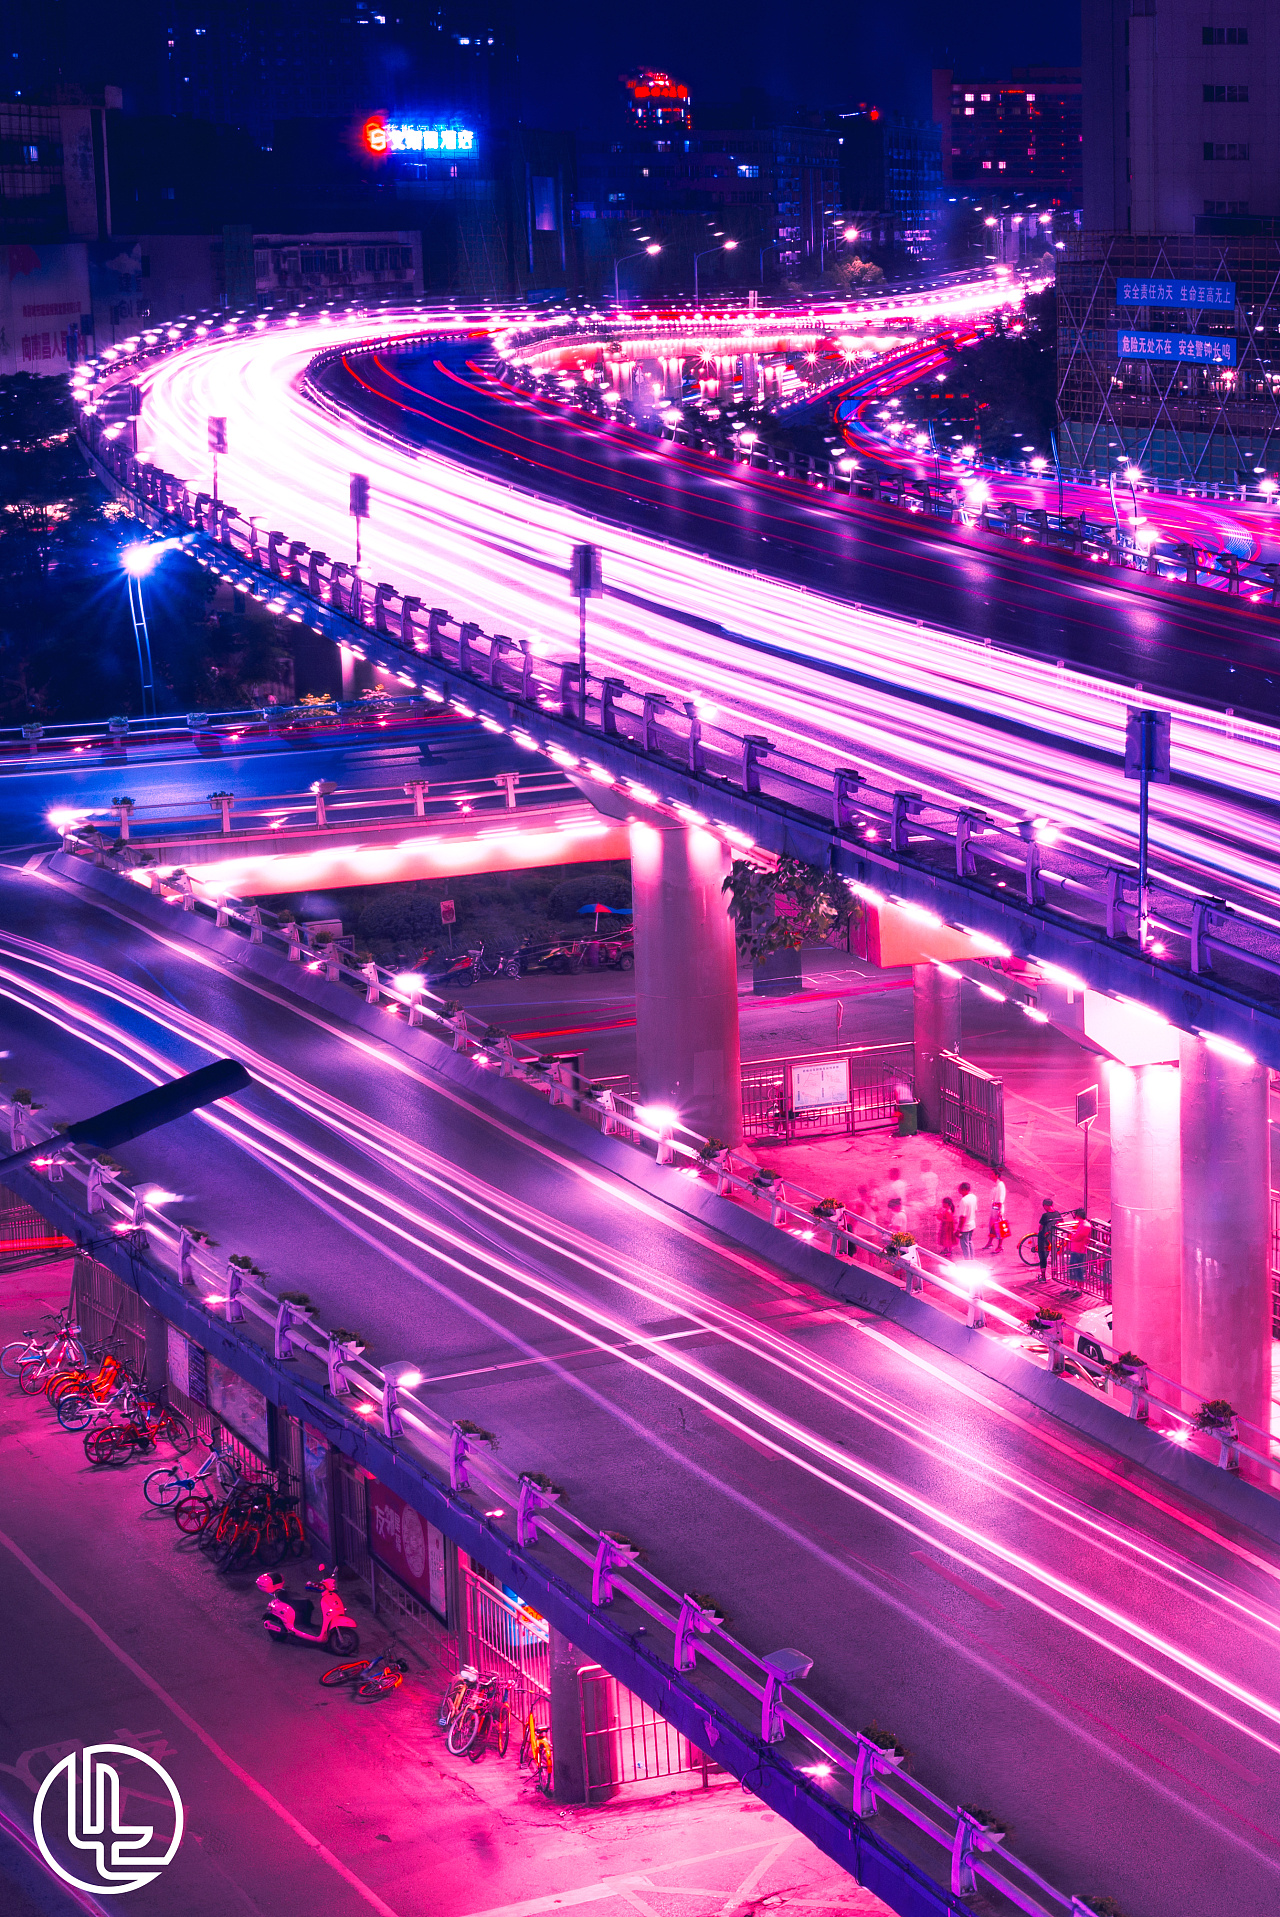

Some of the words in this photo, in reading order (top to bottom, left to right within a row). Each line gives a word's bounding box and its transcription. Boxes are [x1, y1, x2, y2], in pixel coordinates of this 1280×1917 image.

[1123, 283, 1173, 300] 安全责任为天
[1180, 285, 1231, 304] 生命至高无上
[1122, 335, 1172, 355] 危险无处不在
[1178, 339, 1231, 361] 安全警钟长鸣
